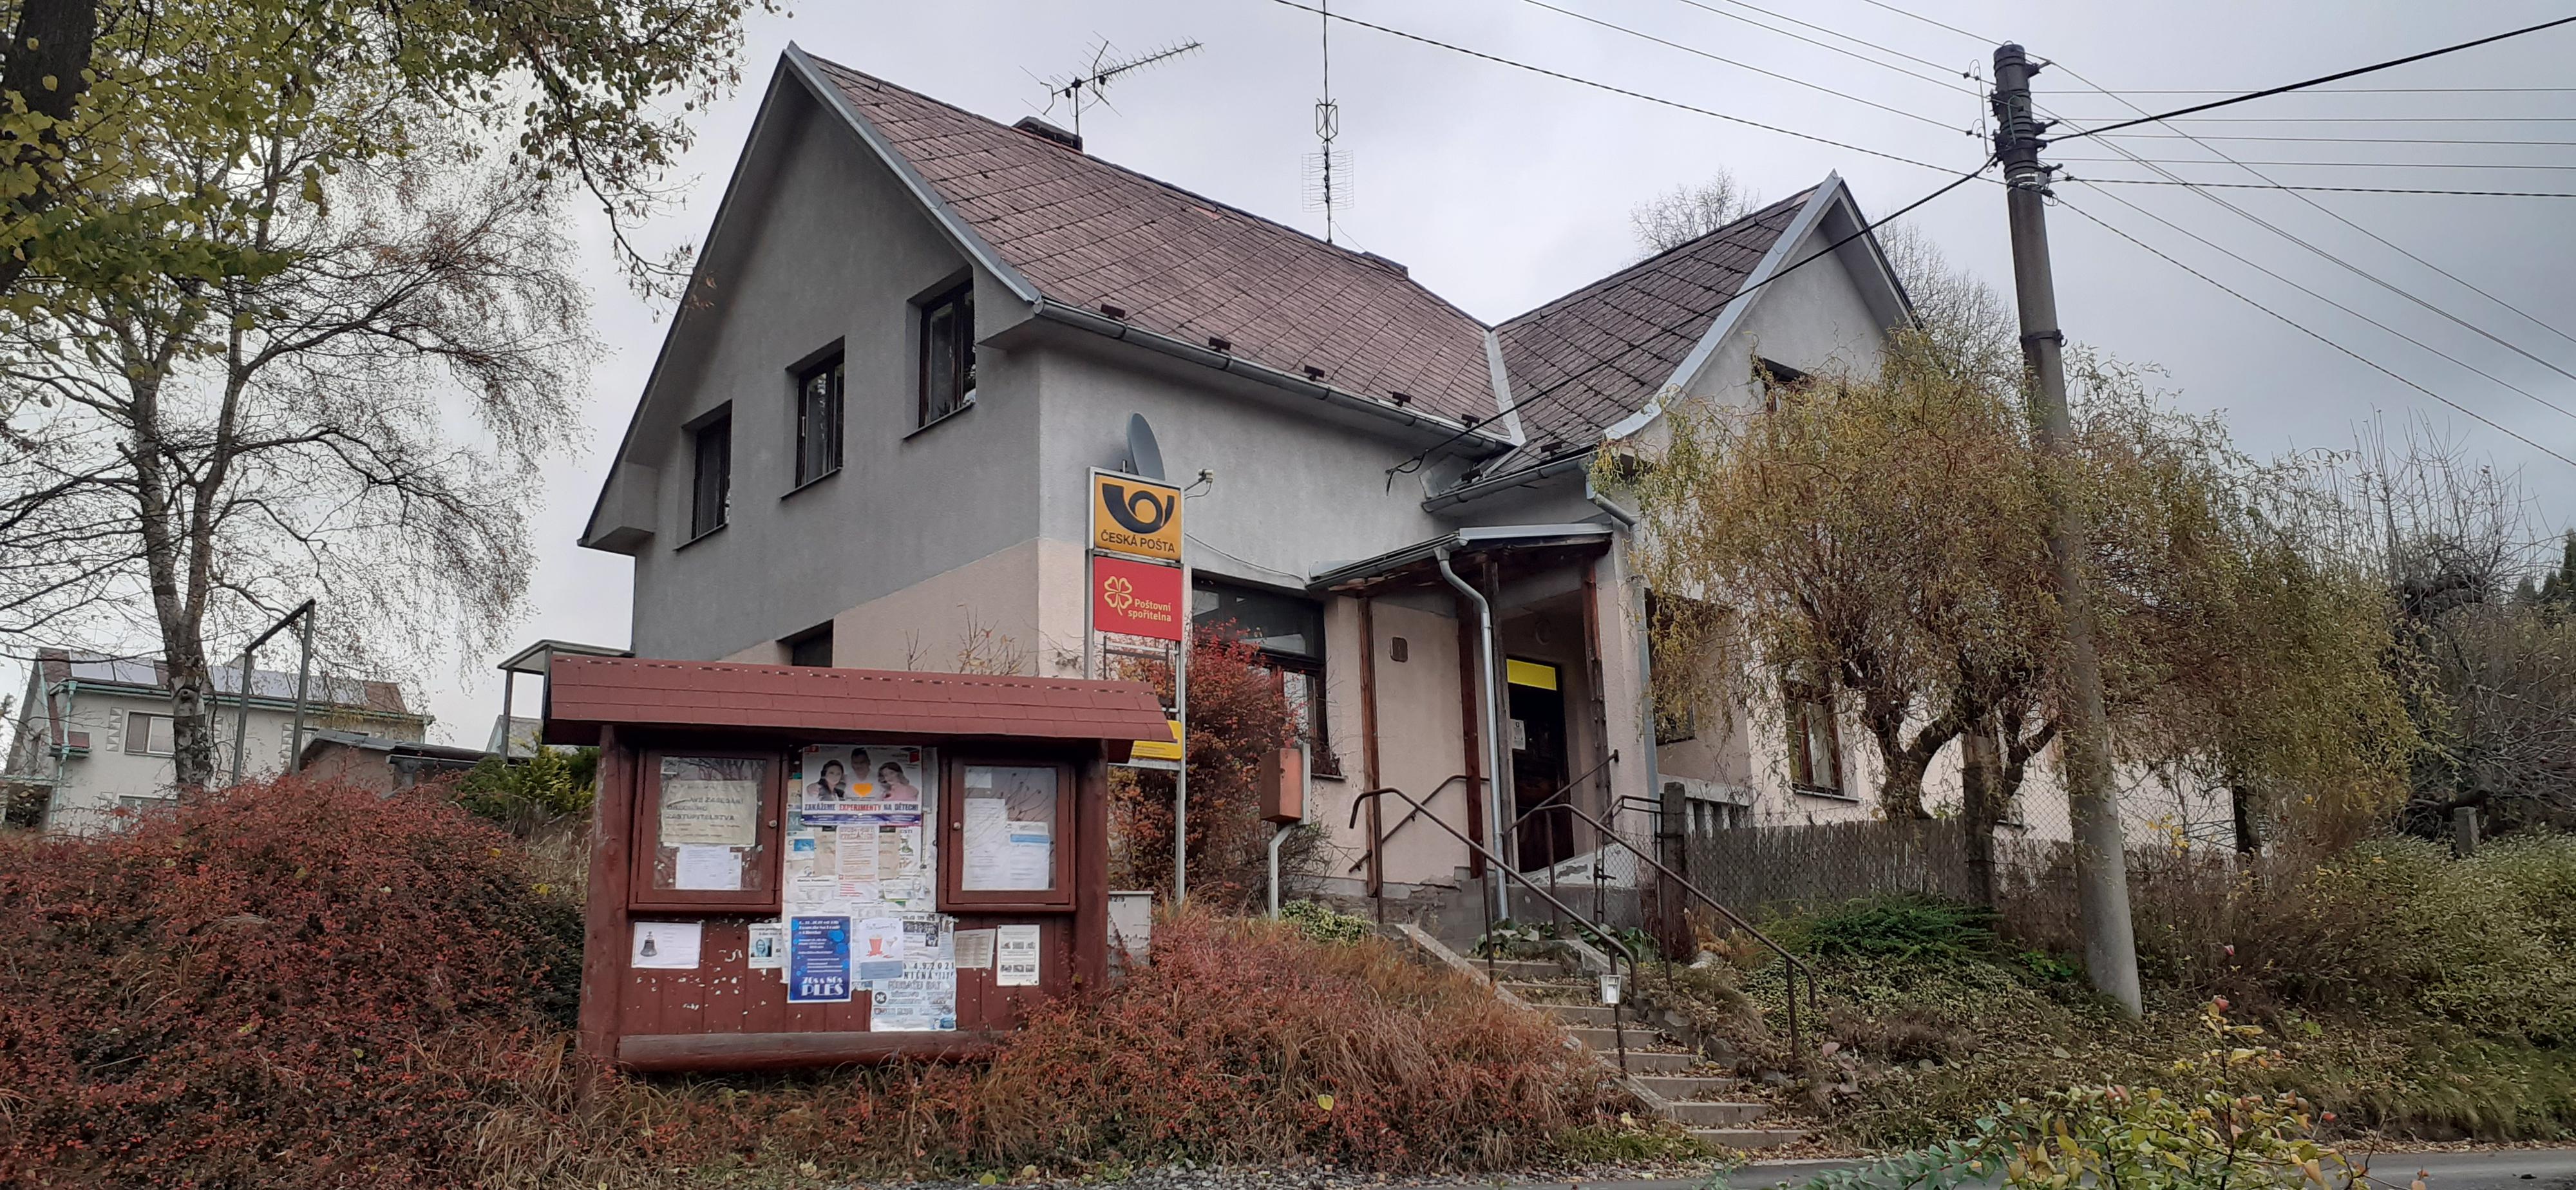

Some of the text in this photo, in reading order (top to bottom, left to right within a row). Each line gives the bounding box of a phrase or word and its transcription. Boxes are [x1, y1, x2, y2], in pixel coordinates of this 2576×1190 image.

[1101, 530, 1175, 552] ČESKÁ POŠTA
[1135, 598, 1171, 612] Poštovní
[1128, 609, 1171, 622] spořitelna
[801, 983, 844, 996] PLES
